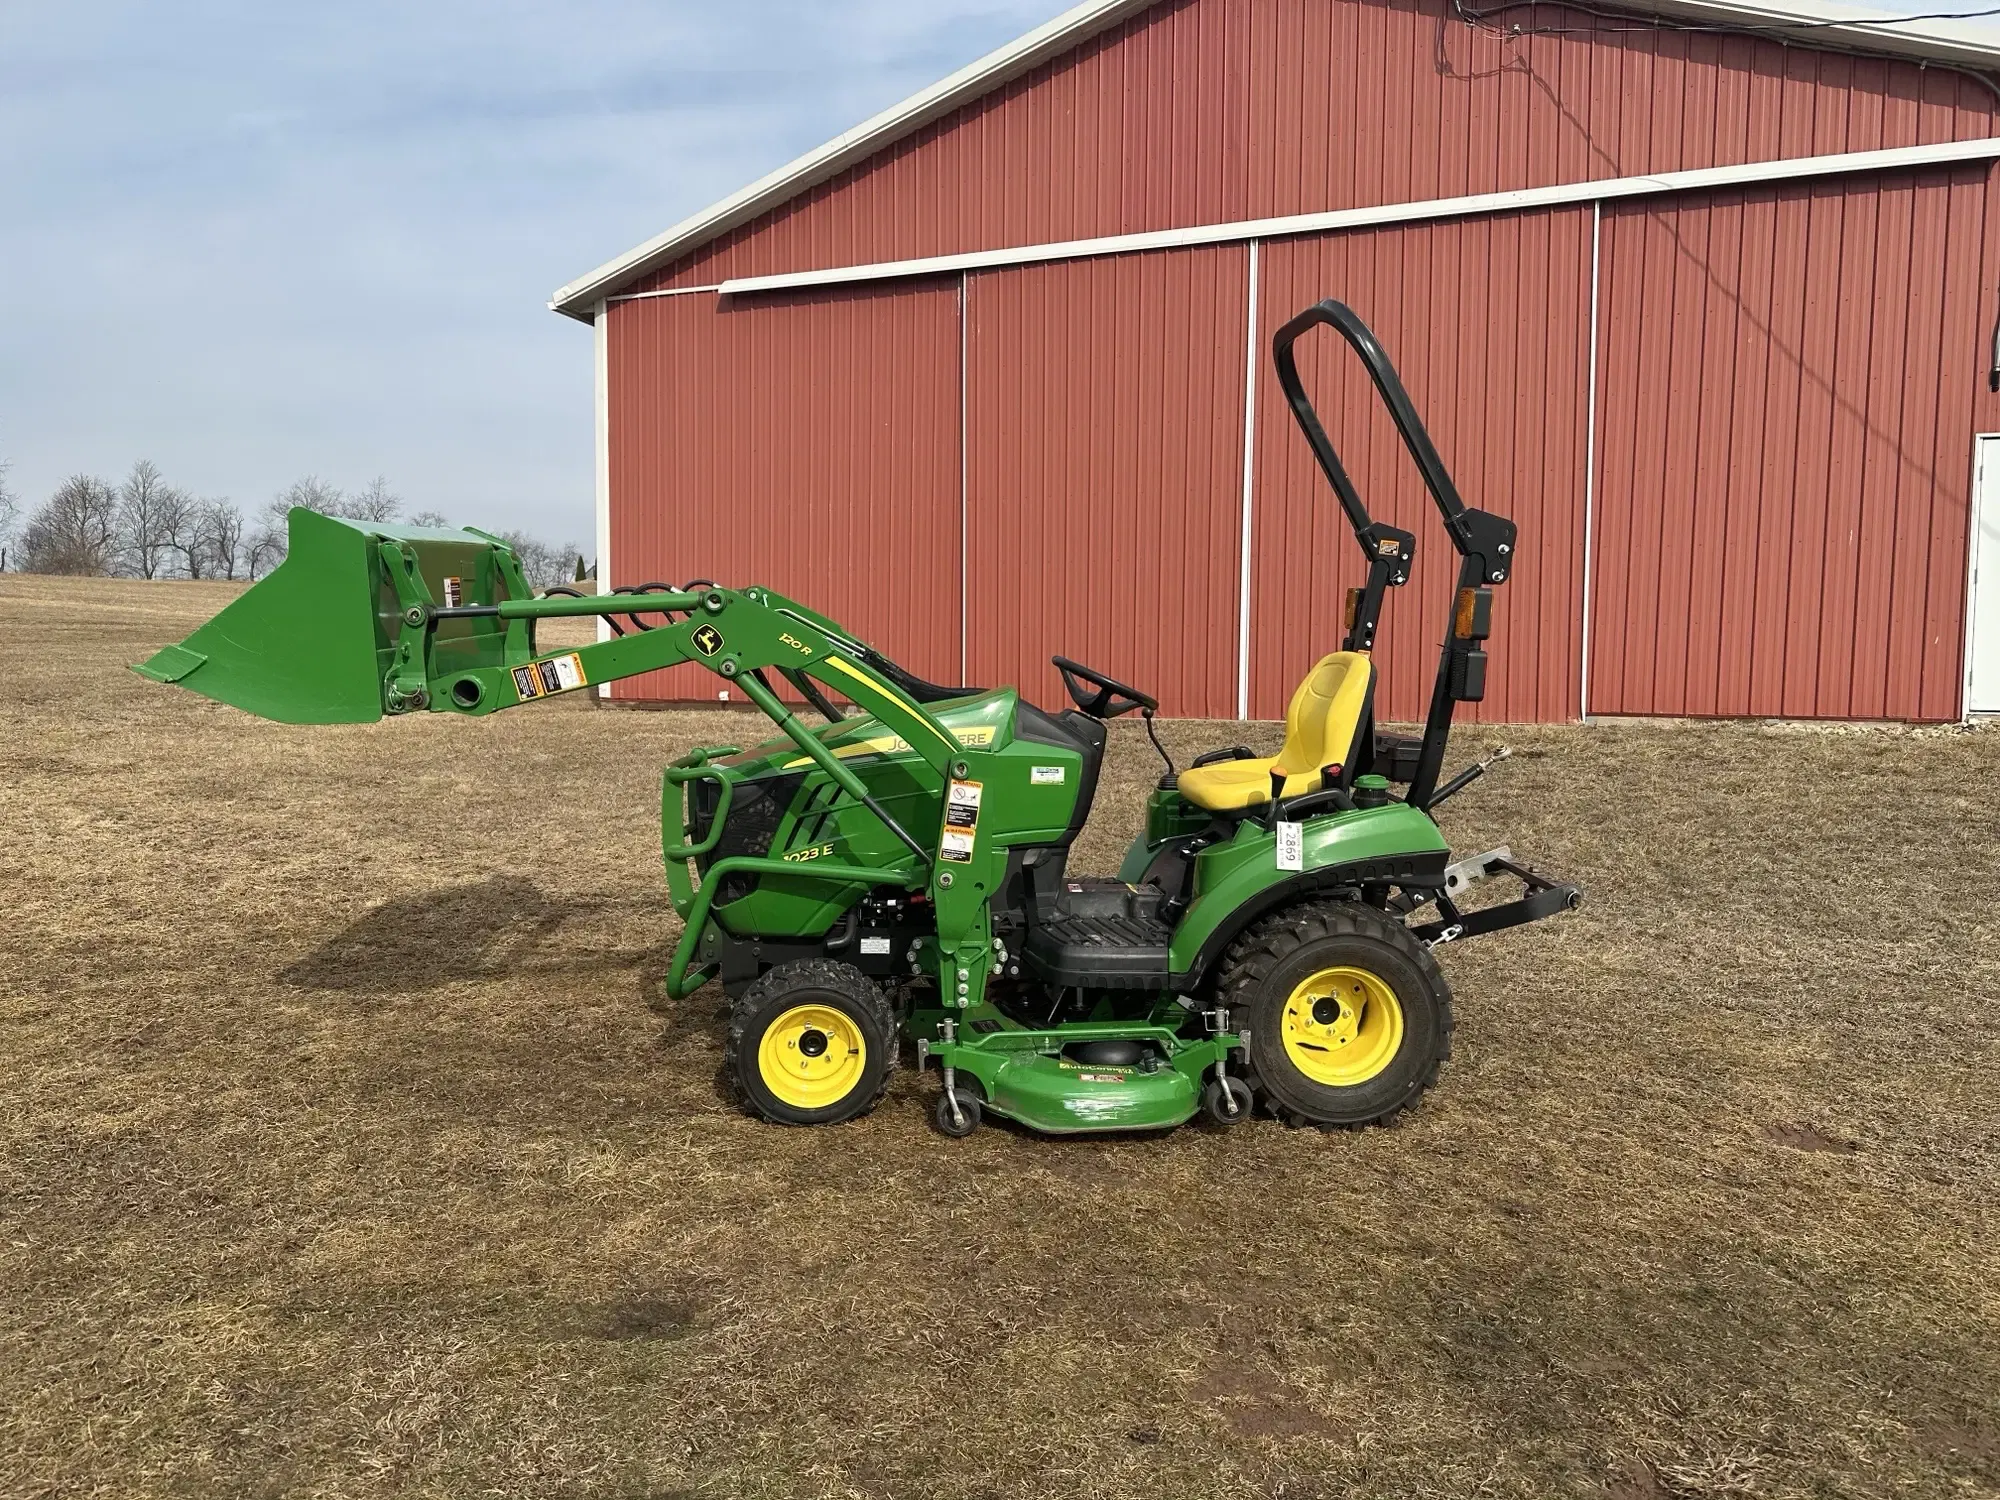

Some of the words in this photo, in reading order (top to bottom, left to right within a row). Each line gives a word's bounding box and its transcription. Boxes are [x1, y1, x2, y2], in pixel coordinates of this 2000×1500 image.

[888, 738, 912, 751] JO
[956, 733, 987, 744] ERE
[1286, 833, 1297, 861] 2869
